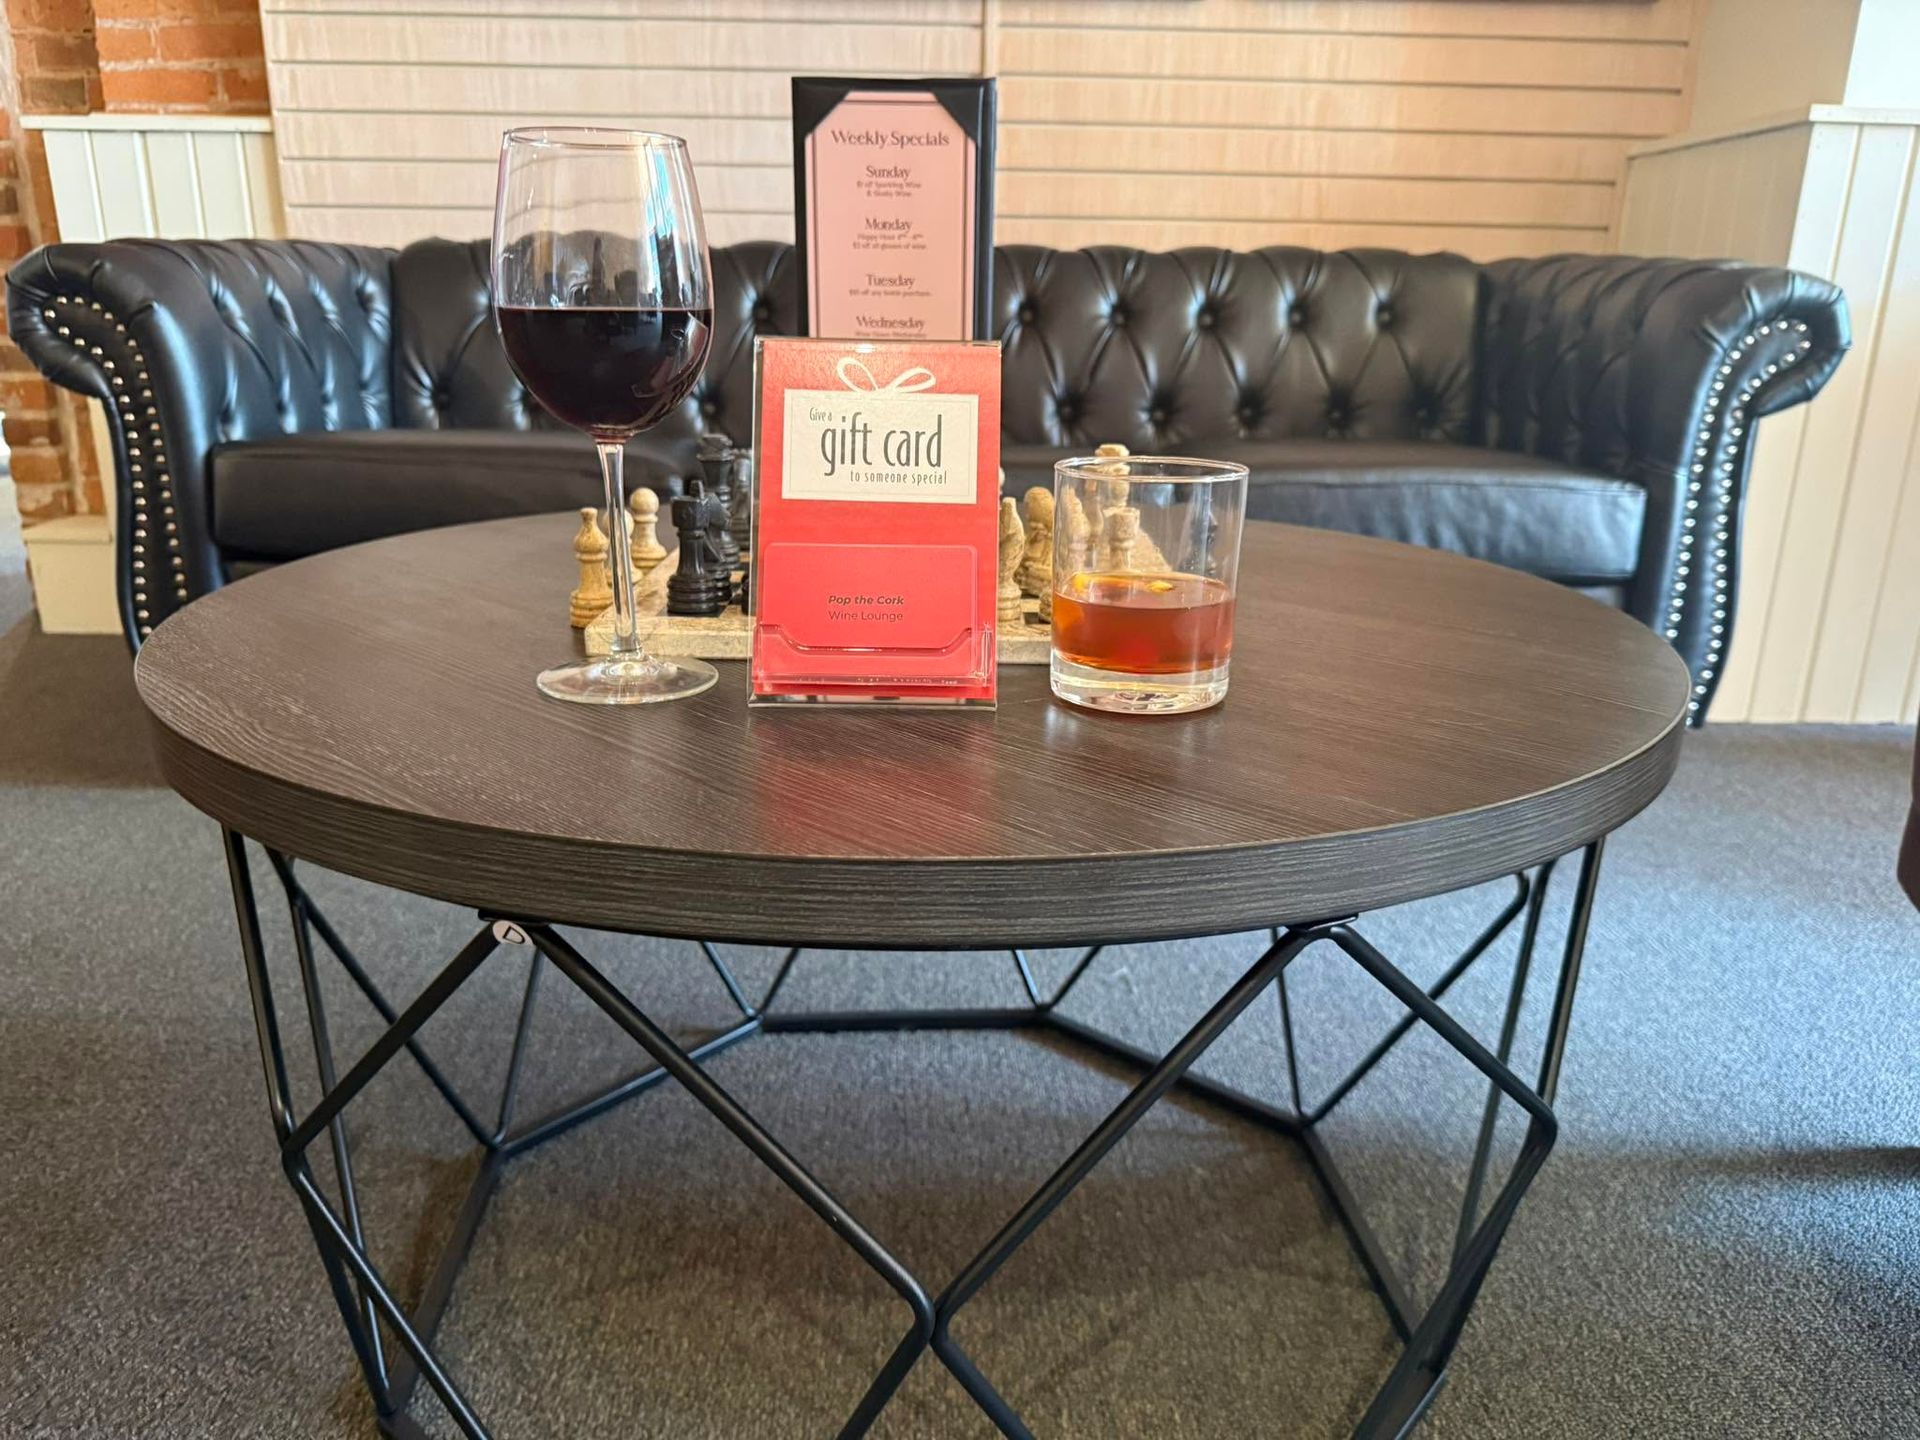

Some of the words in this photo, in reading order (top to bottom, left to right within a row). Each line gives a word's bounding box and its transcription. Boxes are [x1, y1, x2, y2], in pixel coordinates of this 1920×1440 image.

[831, 131, 887, 149] Weekly
[890, 131, 950, 149] Specials
[866, 165, 911, 181] Sunday
[865, 218, 913, 233] Monday
[866, 273, 915, 289] Tuesday
[856, 315, 925, 331] Wednesday
[809, 407, 827, 422] Give
[828, 411, 833, 422] a
[821, 412, 872, 477] gift
[883, 414, 942, 467] card
[850, 471, 860, 482] to
[864, 471, 907, 483] someone
[911, 471, 947, 486] special
[828, 595, 851, 606] Pop
[854, 595, 874, 604] the
[877, 595, 904, 605] Cork
[828, 610, 858, 620] Wine
[861, 611, 903, 623] Lounge
